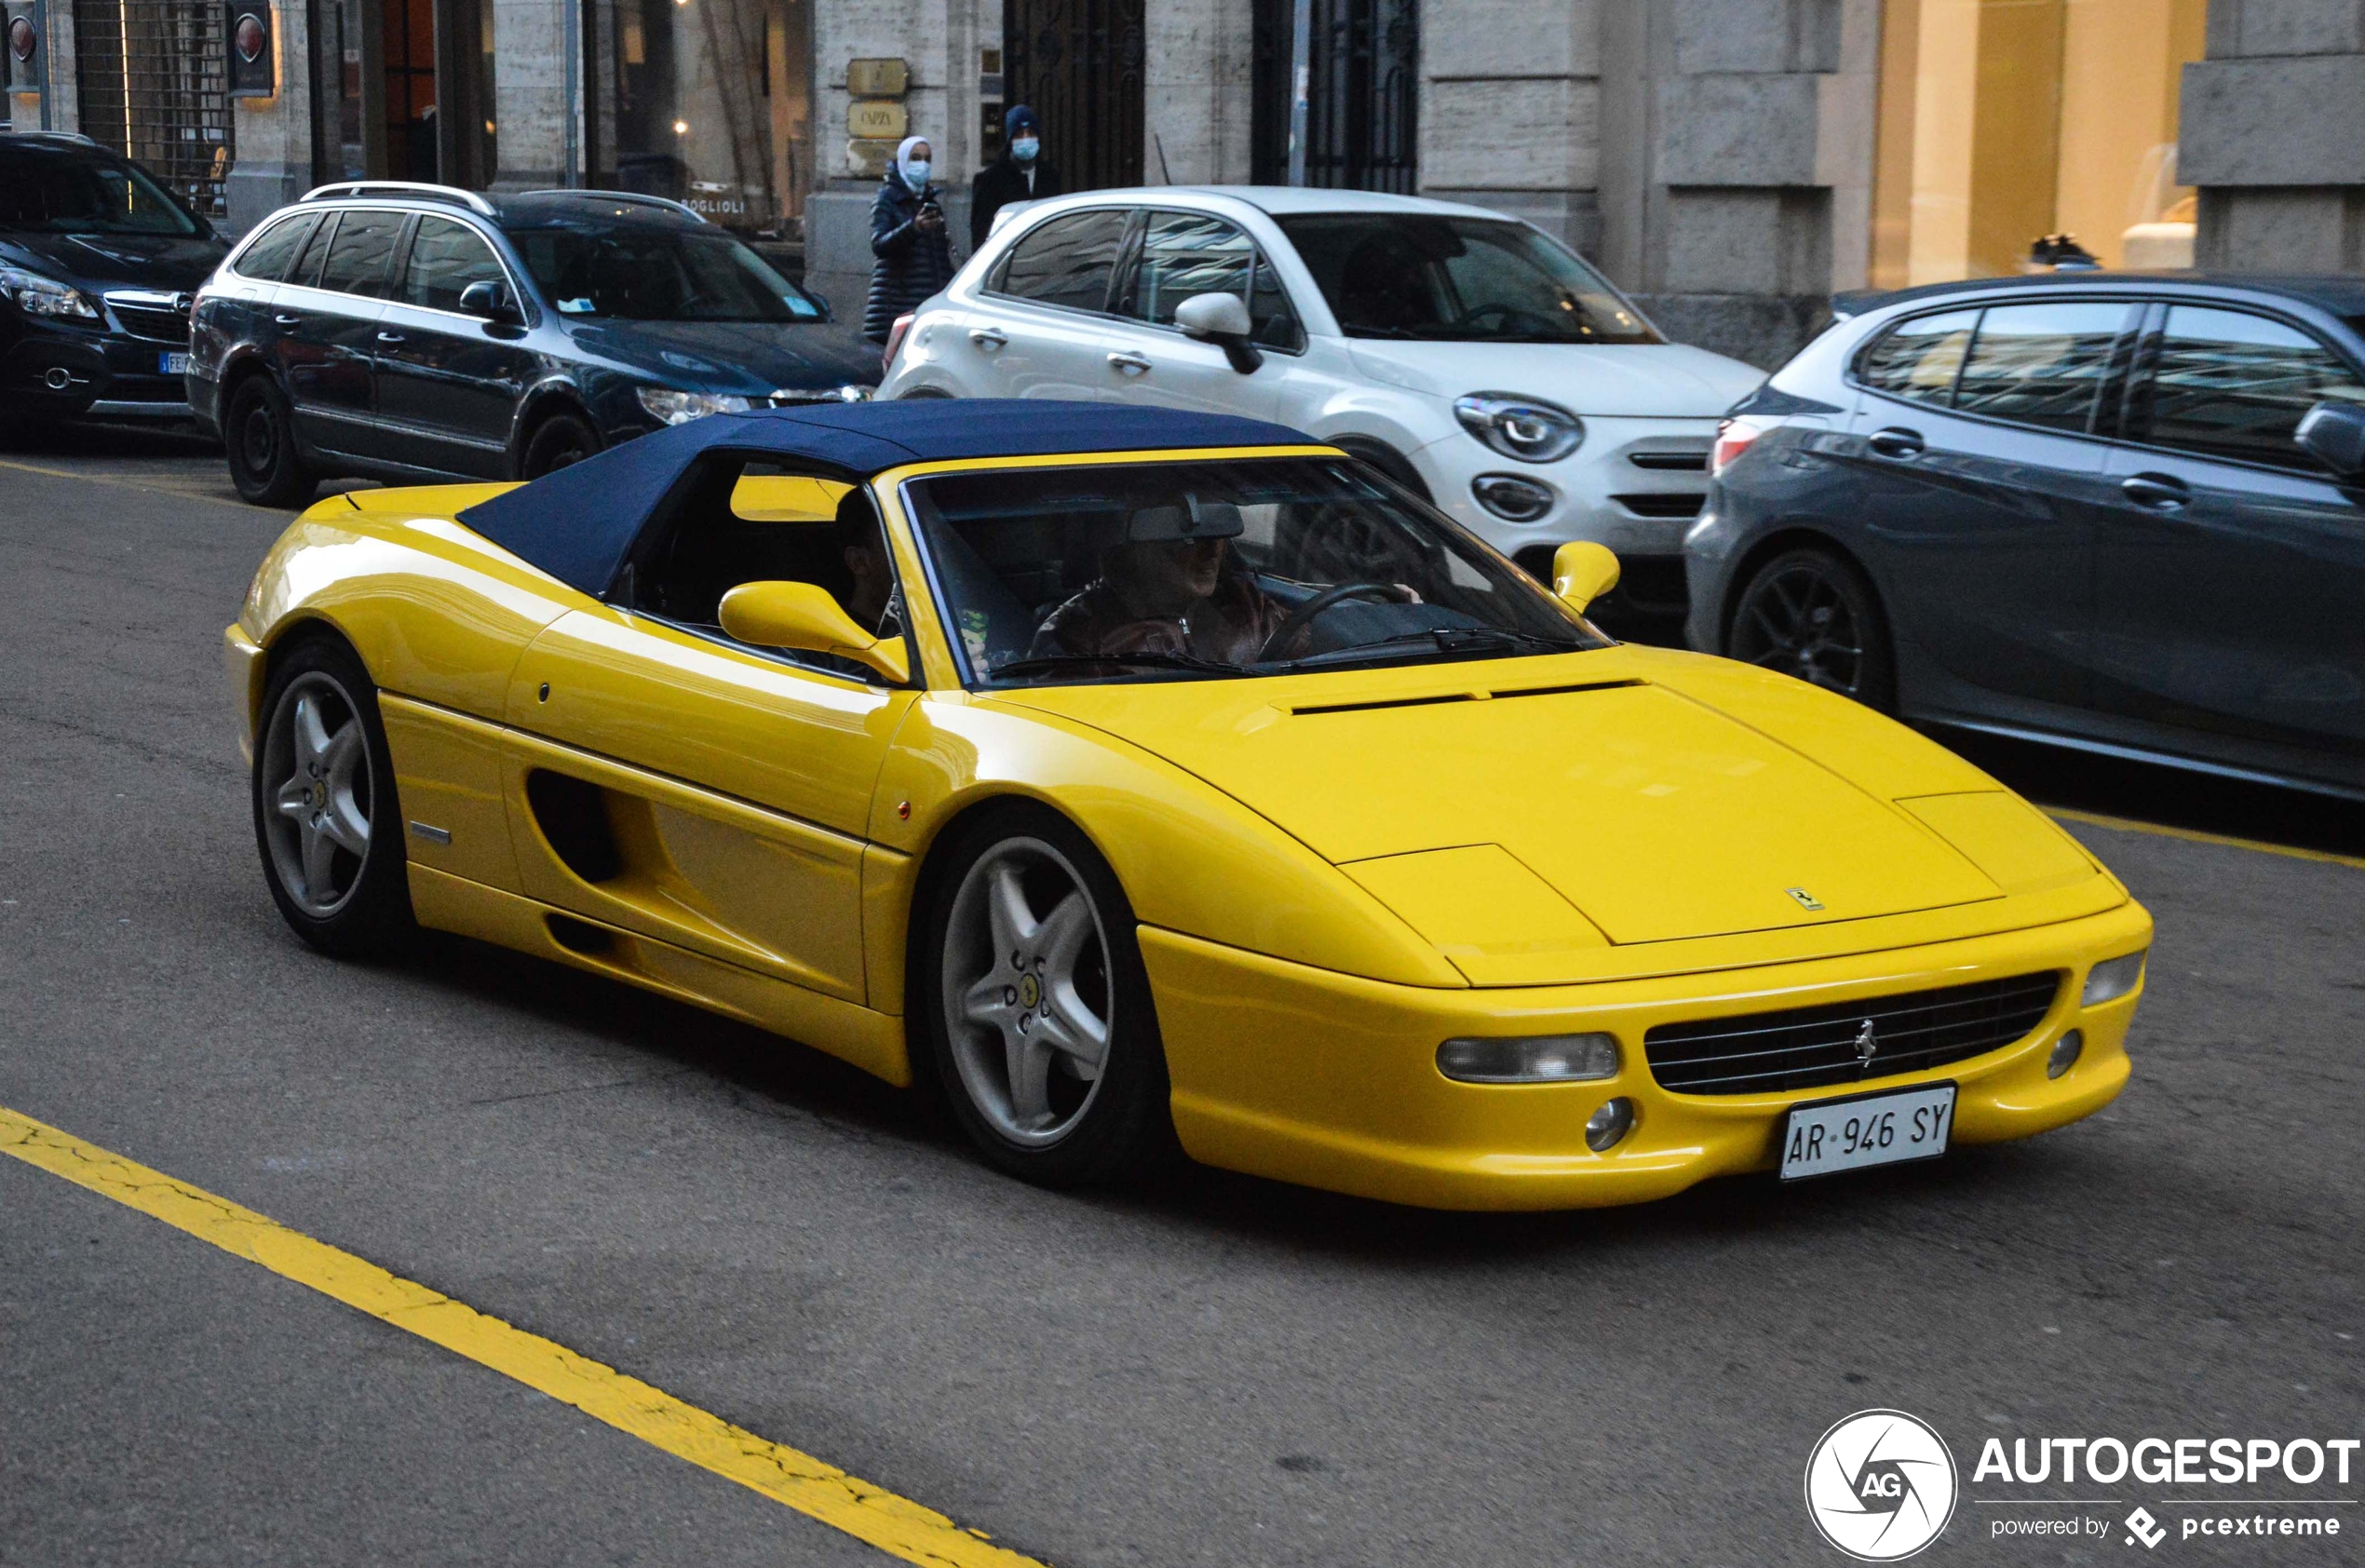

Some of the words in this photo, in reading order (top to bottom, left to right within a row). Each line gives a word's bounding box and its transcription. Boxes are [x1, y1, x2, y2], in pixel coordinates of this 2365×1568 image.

[1788, 1123, 1825, 1164] AR
[1843, 1112, 1896, 1155] 946
[1911, 1103, 1948, 1143] SY
